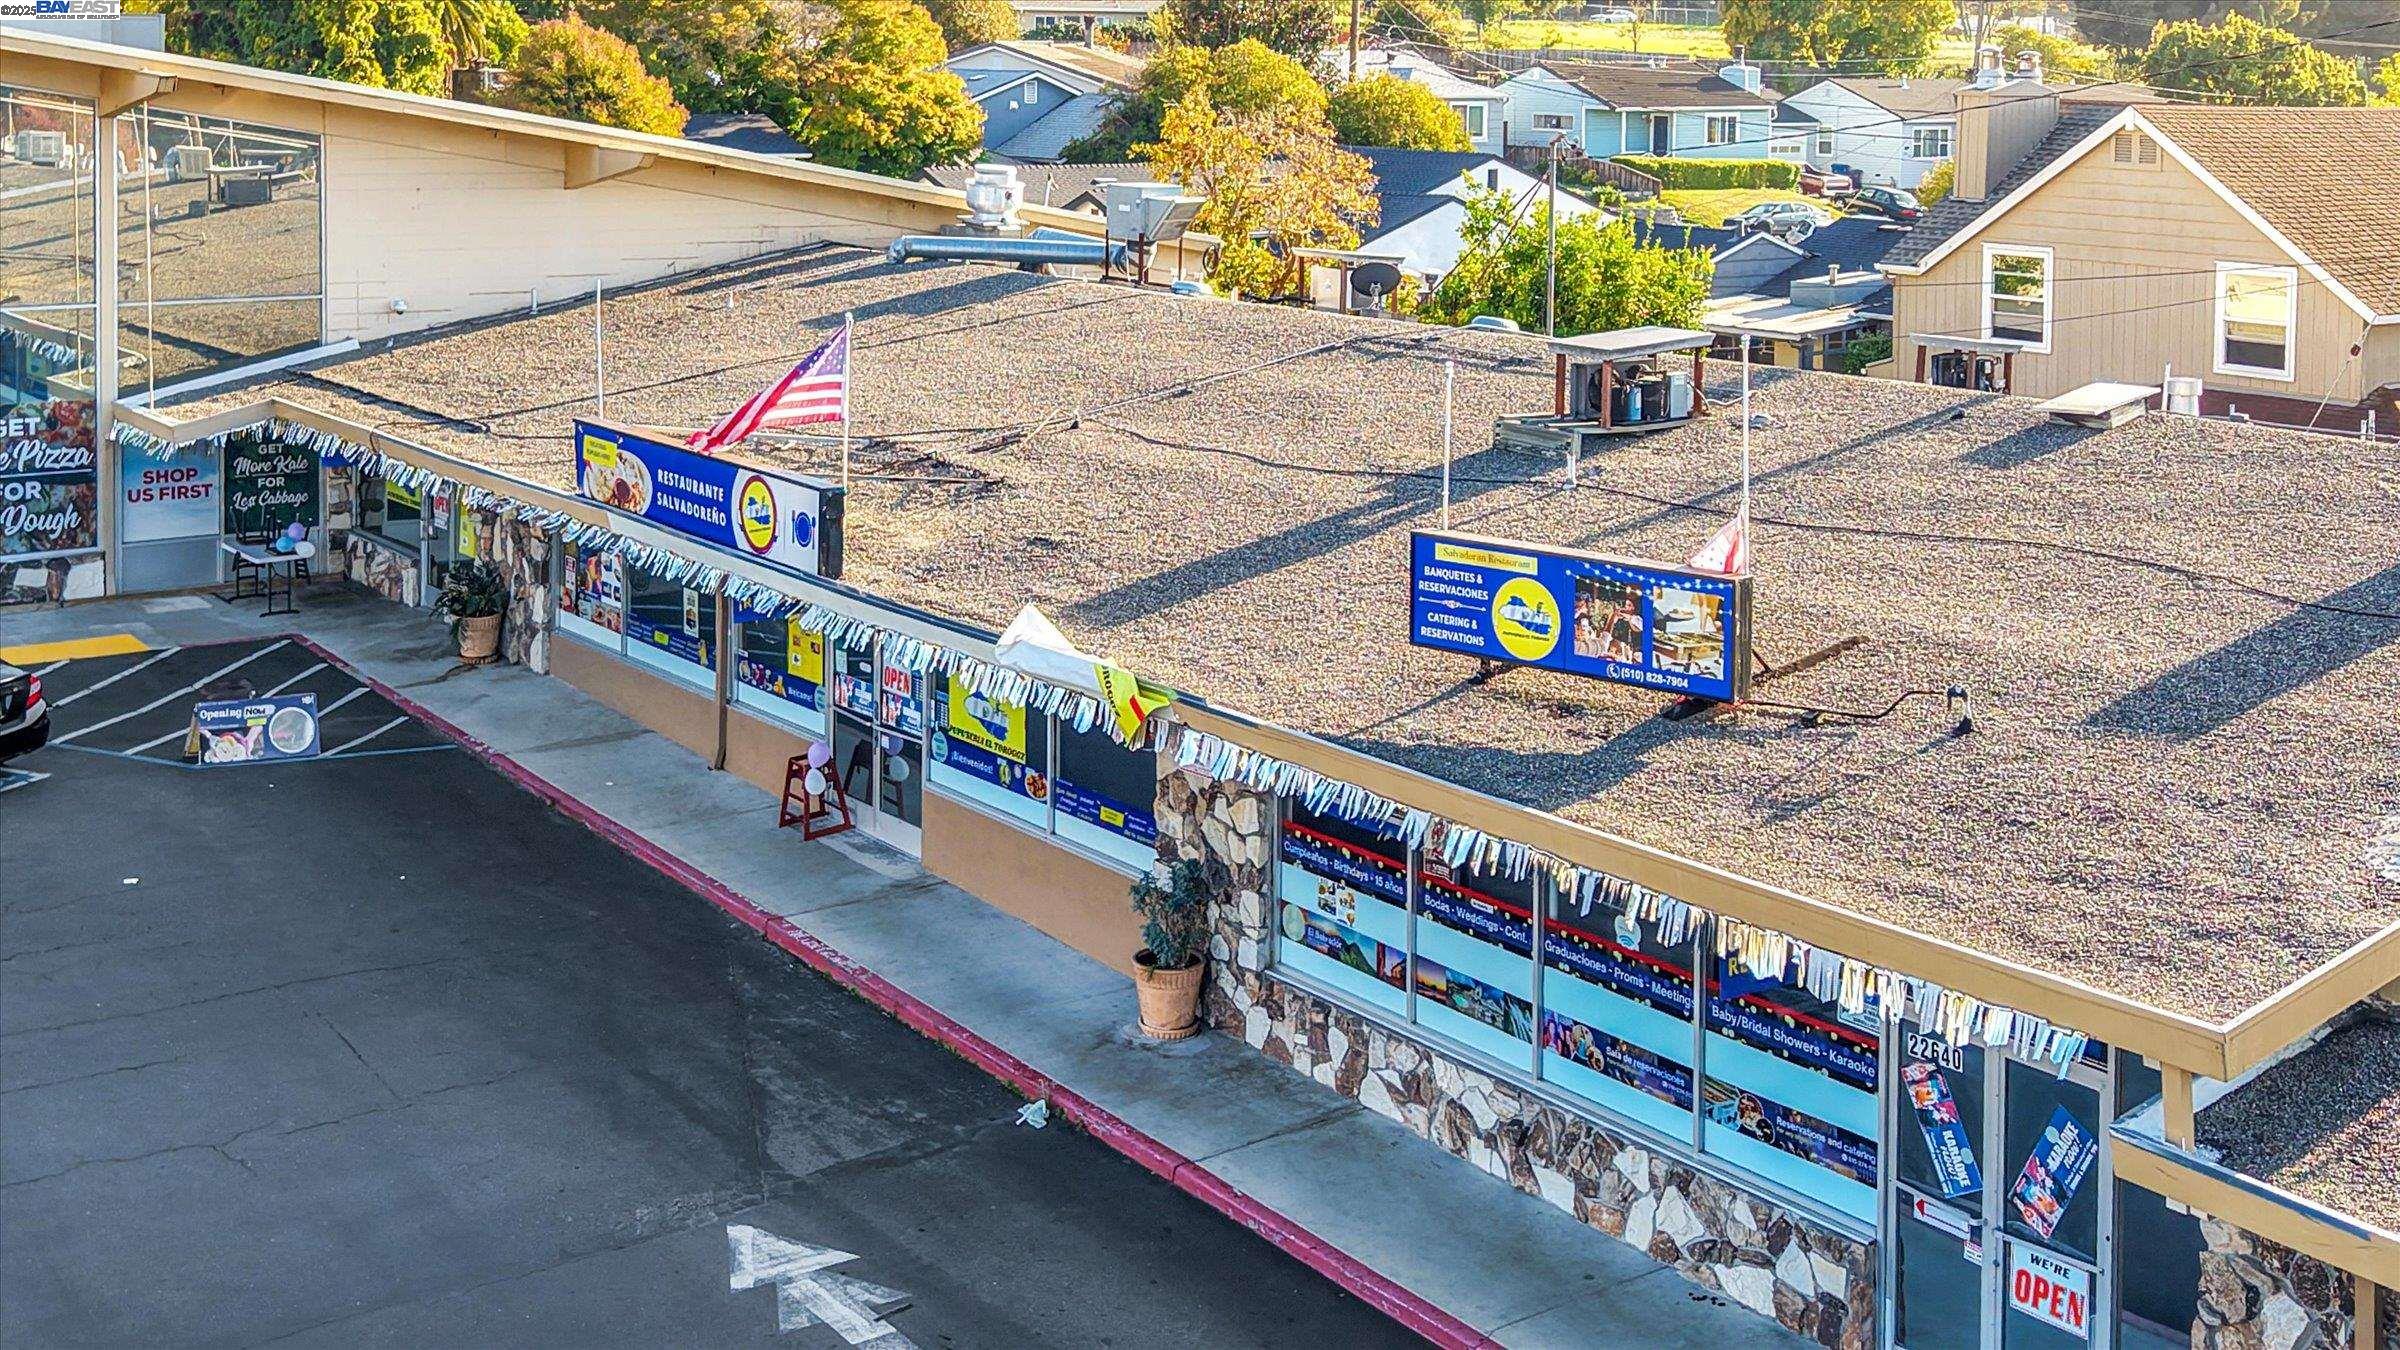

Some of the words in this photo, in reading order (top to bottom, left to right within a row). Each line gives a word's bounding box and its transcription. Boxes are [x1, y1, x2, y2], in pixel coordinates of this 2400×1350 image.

[13, 439, 94, 472] Pizza
[258, 443, 286, 455] GET
[143, 467, 199, 484] SHOP
[233, 456, 274, 477] More
[274, 454, 310, 474] Kale
[0, 481, 42, 502] OR
[127, 488, 156, 503] US
[159, 483, 213, 502] FIRST
[257, 476, 285, 488] FOR
[657, 468, 724, 502] RESTAURANTE
[232, 491, 256, 512] Less
[258, 491, 310, 508] Cabbage
[656, 491, 727, 526] SALVADOREÑO
[1, 502, 81, 540] Dough
[1424, 566, 1475, 584] BANQUETES
[1476, 574, 1483, 584] &
[1418, 581, 1488, 600] RESERVACIONES
[1427, 612, 1470, 628] CATERING
[1471, 620, 1478, 630] &
[1420, 626, 1485, 645] RESERVATIONS
[884, 666, 910, 694] OPEN
[1620, 667, 1644, 683] (510)
[199, 708, 242, 722] Opening
[1334, 855, 1369, 882] Birthdays
[1375, 875, 1383, 887] 15
[1385, 879, 1404, 895] años
[1424, 894, 1450, 914] Bodas
[1456, 907, 1499, 934] Weddings
[1545, 939, 1607, 974] Graduaciones
[1614, 967, 1644, 988] Proms
[1711, 1004, 1771, 1038] Baby/Bridal
[1773, 1028, 1821, 1057] Showers
[1829, 1050, 1876, 1078] Karaoke
[1908, 1035, 1963, 1072] 22640
[1827, 1138, 1842, 1149] and
[2047, 1121, 2079, 1172] KARAOKE
[1942, 1131, 1971, 1188] KARAOKE
[2030, 1252, 2070, 1279] WE'RE
[2014, 1268, 2087, 1328] OPEN
